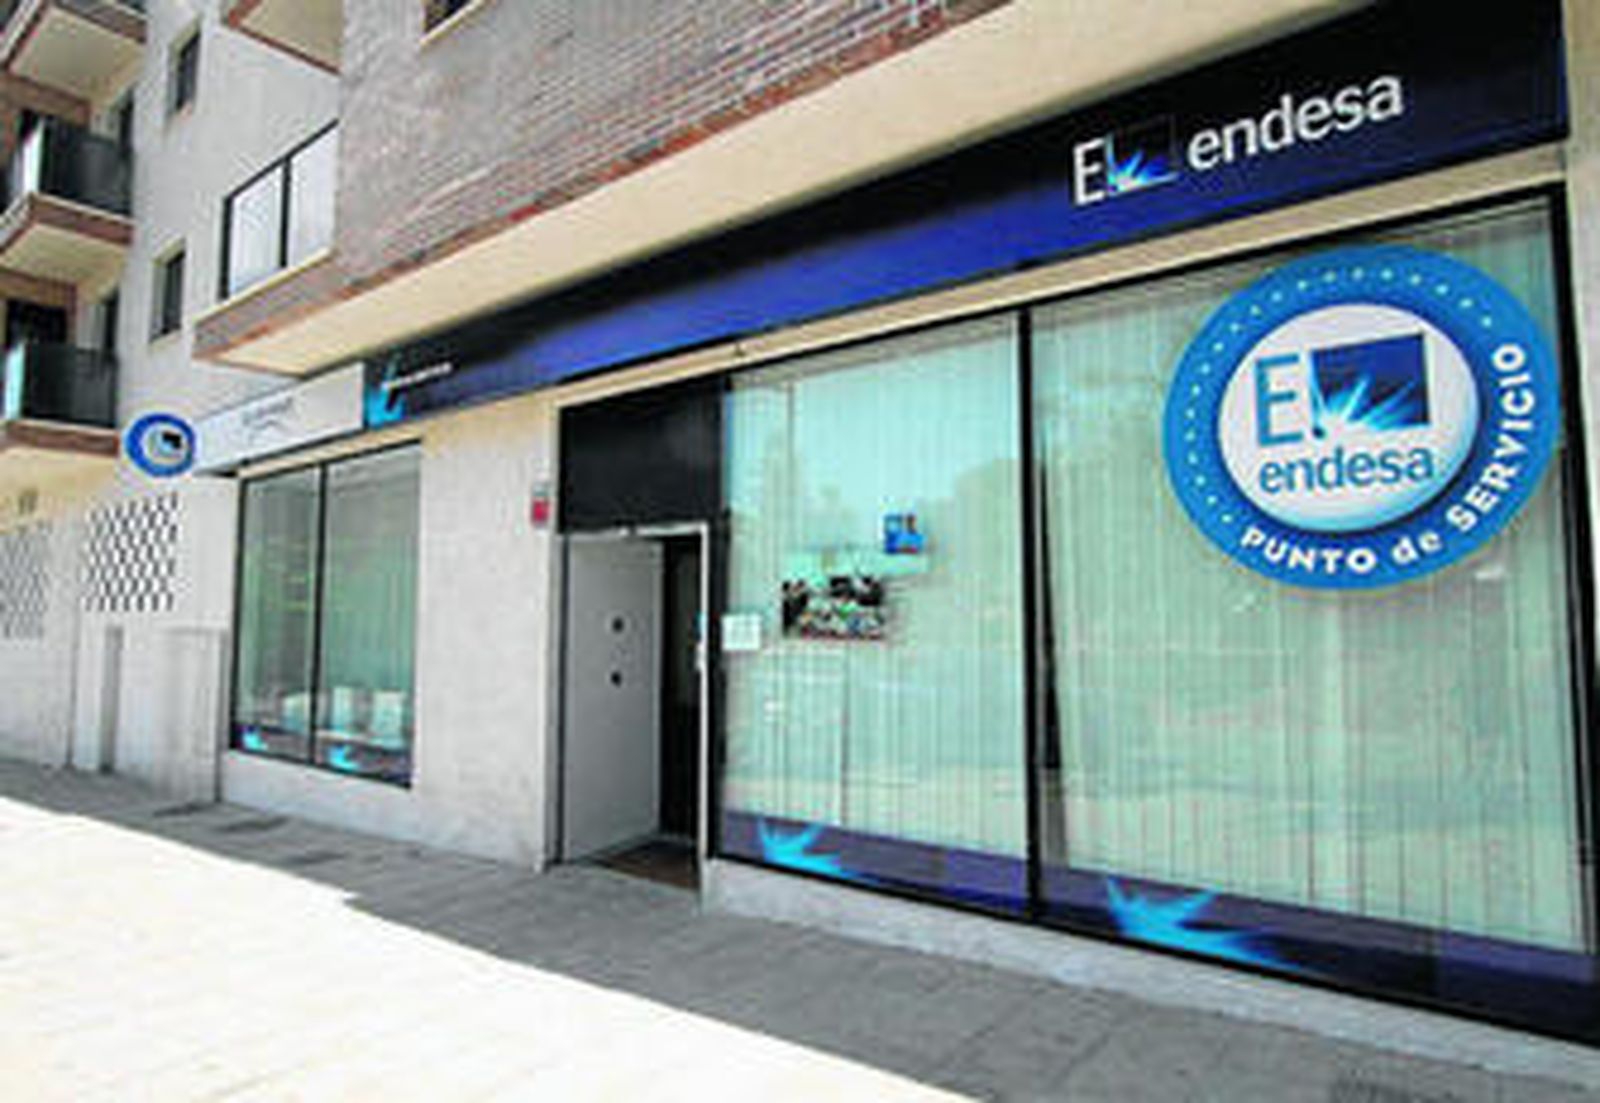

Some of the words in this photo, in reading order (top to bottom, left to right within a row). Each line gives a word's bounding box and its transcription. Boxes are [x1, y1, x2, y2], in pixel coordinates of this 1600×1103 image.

[1187, 74, 1405, 171] endesa
[1241, 526, 1377, 575] PUNTO
[1391, 530, 1442, 566] de
[1445, 342, 1536, 533] SERVICIO
[1258, 445, 1435, 495] endesa
